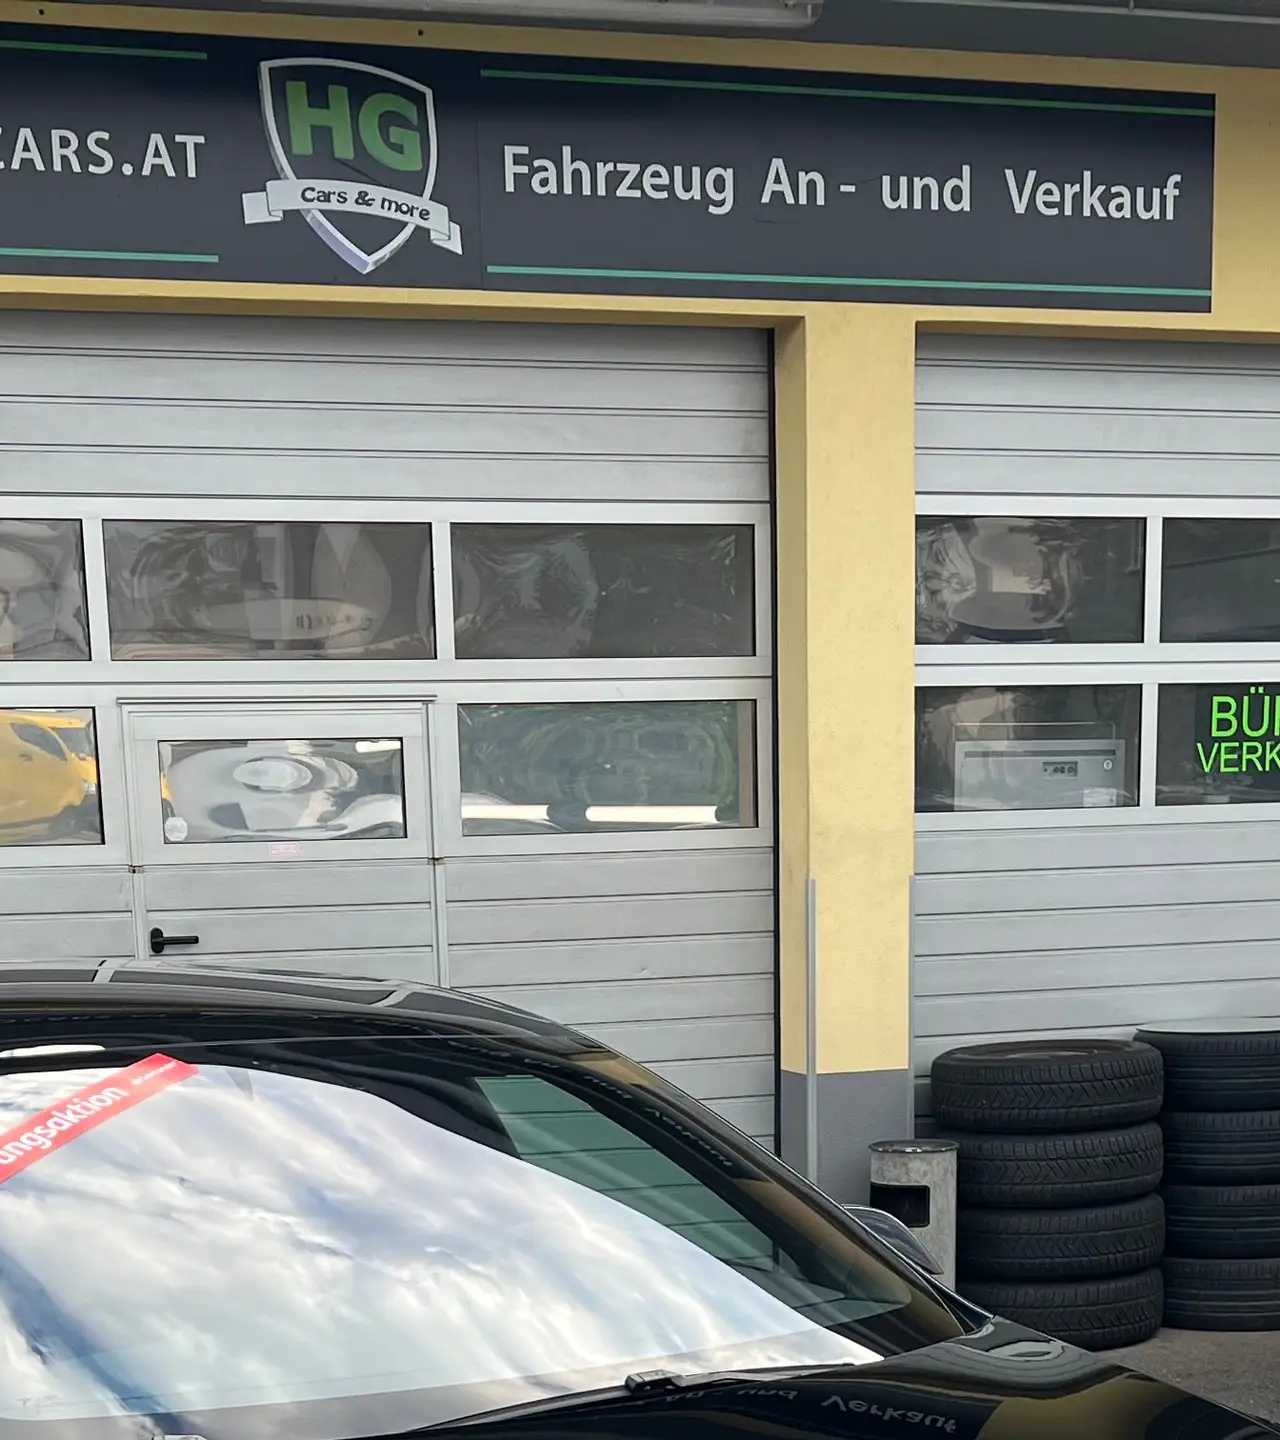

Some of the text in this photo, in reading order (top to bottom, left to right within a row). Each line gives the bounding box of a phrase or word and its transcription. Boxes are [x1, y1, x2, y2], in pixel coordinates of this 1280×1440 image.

[285, 79, 423, 172] HG
[300, 186, 431, 221] Cars & more
[503, 145, 735, 215] Fahrzeug
[881, 164, 972, 212] und
[1004, 168, 1182, 221] Verkauf
